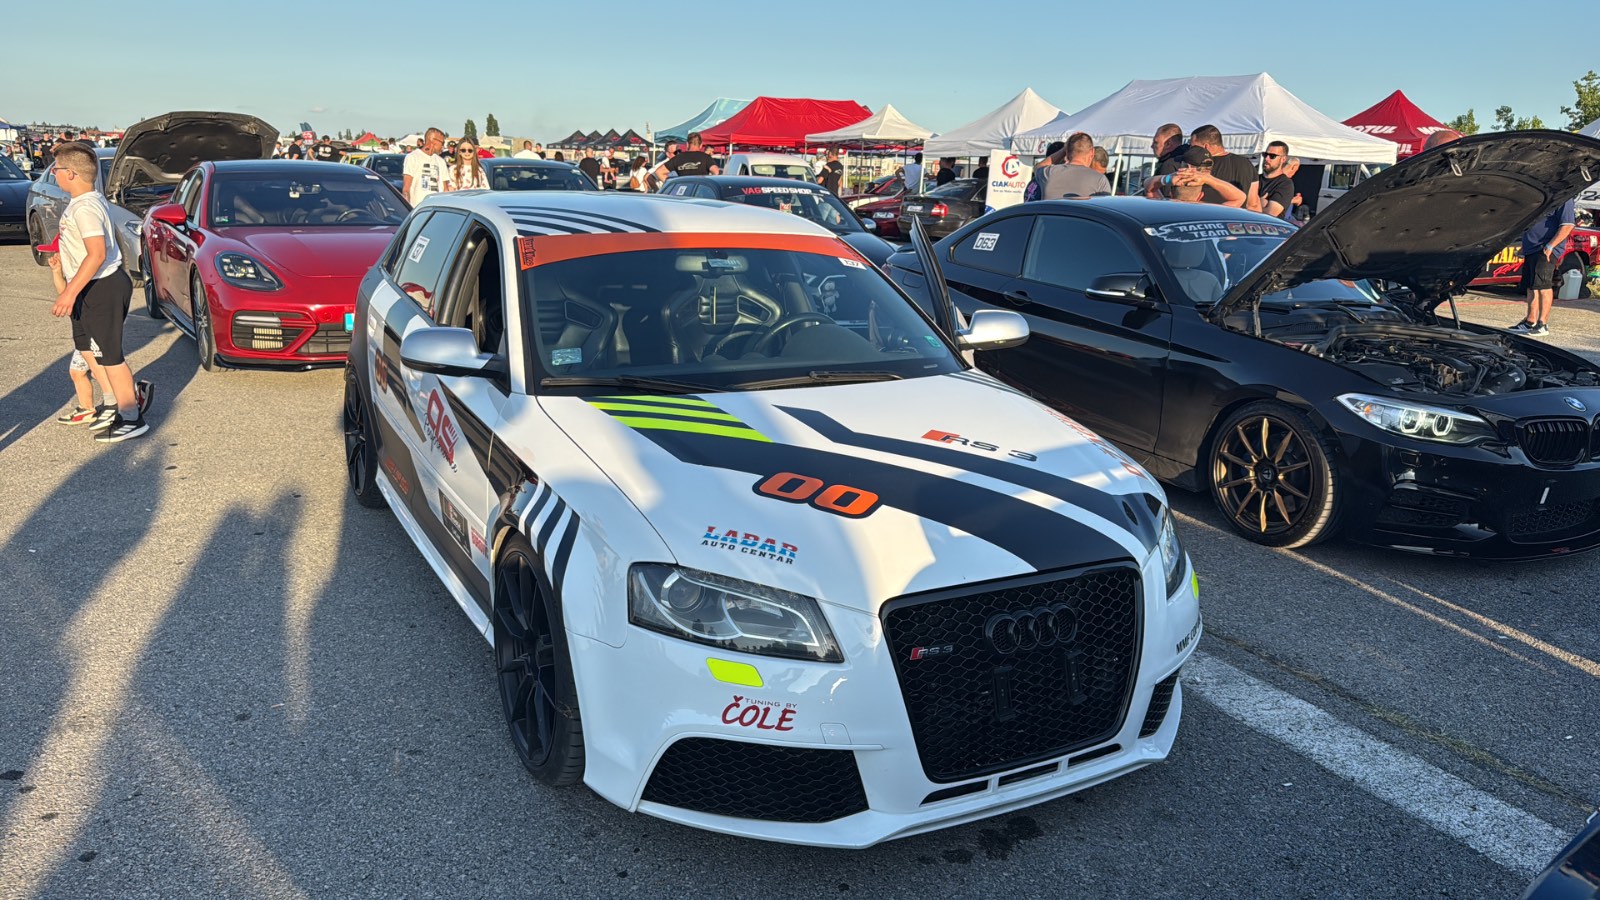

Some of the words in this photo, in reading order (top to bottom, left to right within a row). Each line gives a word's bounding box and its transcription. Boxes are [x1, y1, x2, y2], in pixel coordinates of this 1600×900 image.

[1348, 126, 1398, 134] OTUL
[1177, 222, 1225, 232] RACING
[1226, 223, 1290, 236] 600+
[1190, 229, 1230, 239] TEAM
[974, 237, 996, 249] 063
[938, 434, 1000, 452] RS
[1007, 449, 1038, 462] 3
[757, 471, 880, 516] 00
[702, 525, 799, 559] LADAR
[701, 539, 736, 551] AUTO
[740, 546, 795, 565] CENTAR
[942, 645, 953, 654] 3
[744, 698, 781, 707] TUNING
